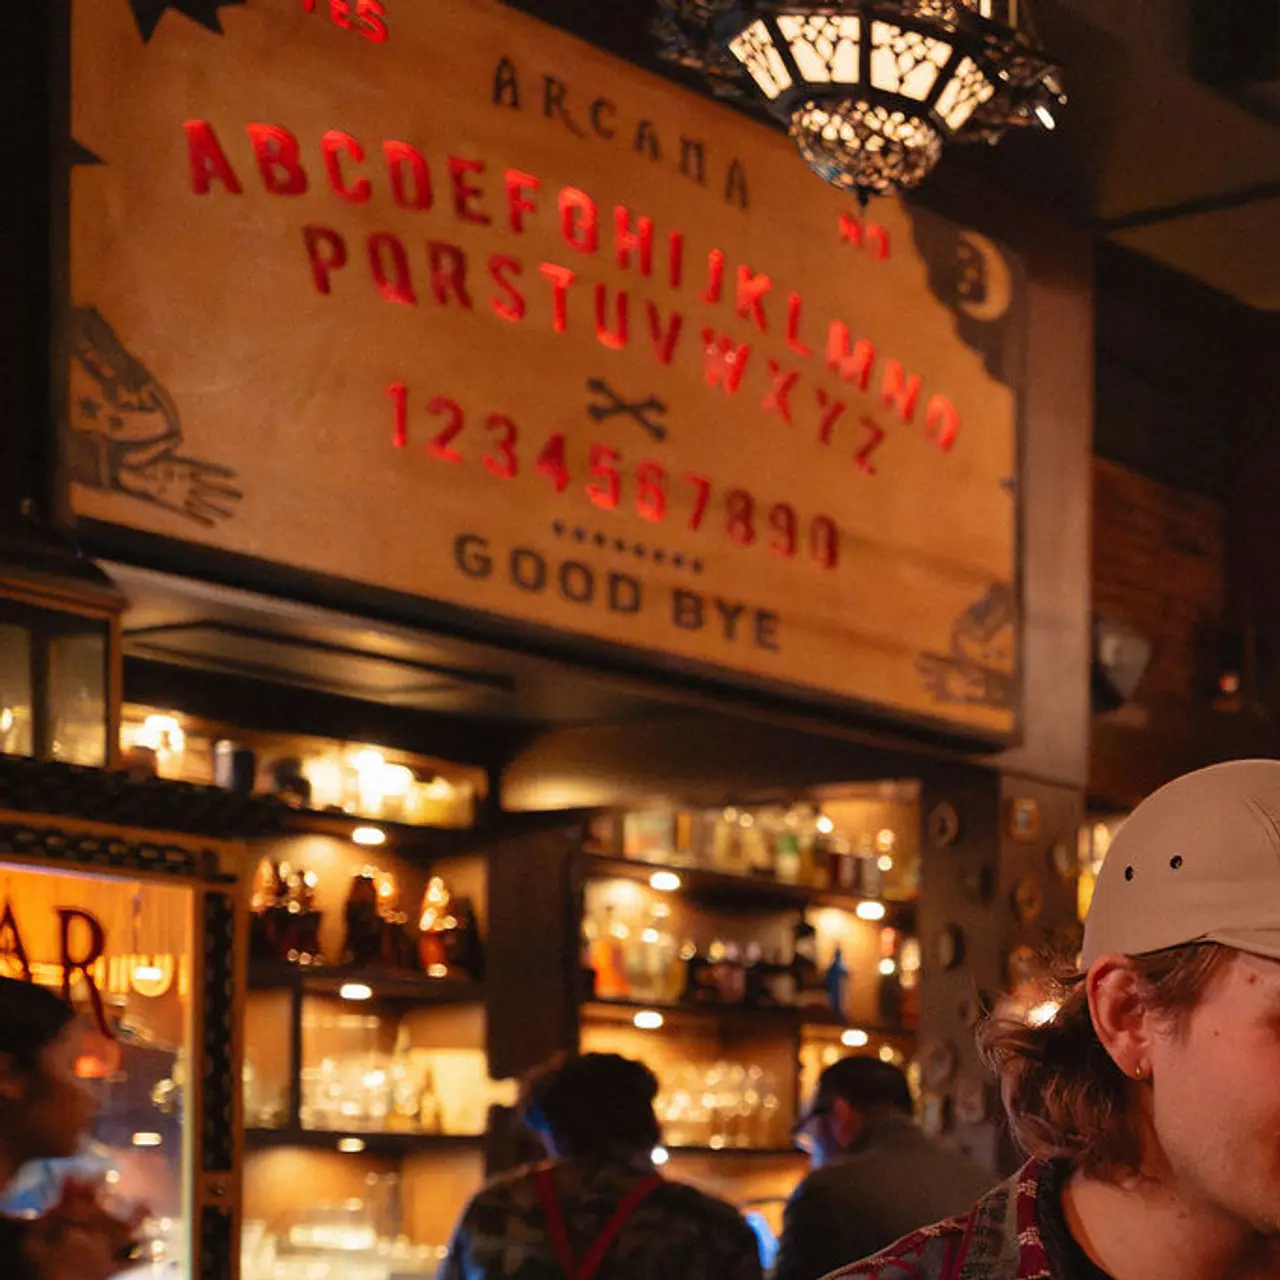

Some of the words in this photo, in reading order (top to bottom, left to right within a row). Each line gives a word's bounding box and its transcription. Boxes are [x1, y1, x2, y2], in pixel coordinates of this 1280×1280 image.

[301, 0, 390, 44] ES
[492, 56, 748, 211] ARCANA
[302, 225, 884, 476] PQRSTUVWXYZ
[382, 382, 840, 570] 1234567890
[453, 532, 643, 617] GOOD
[671, 587, 781, 652] BYE
